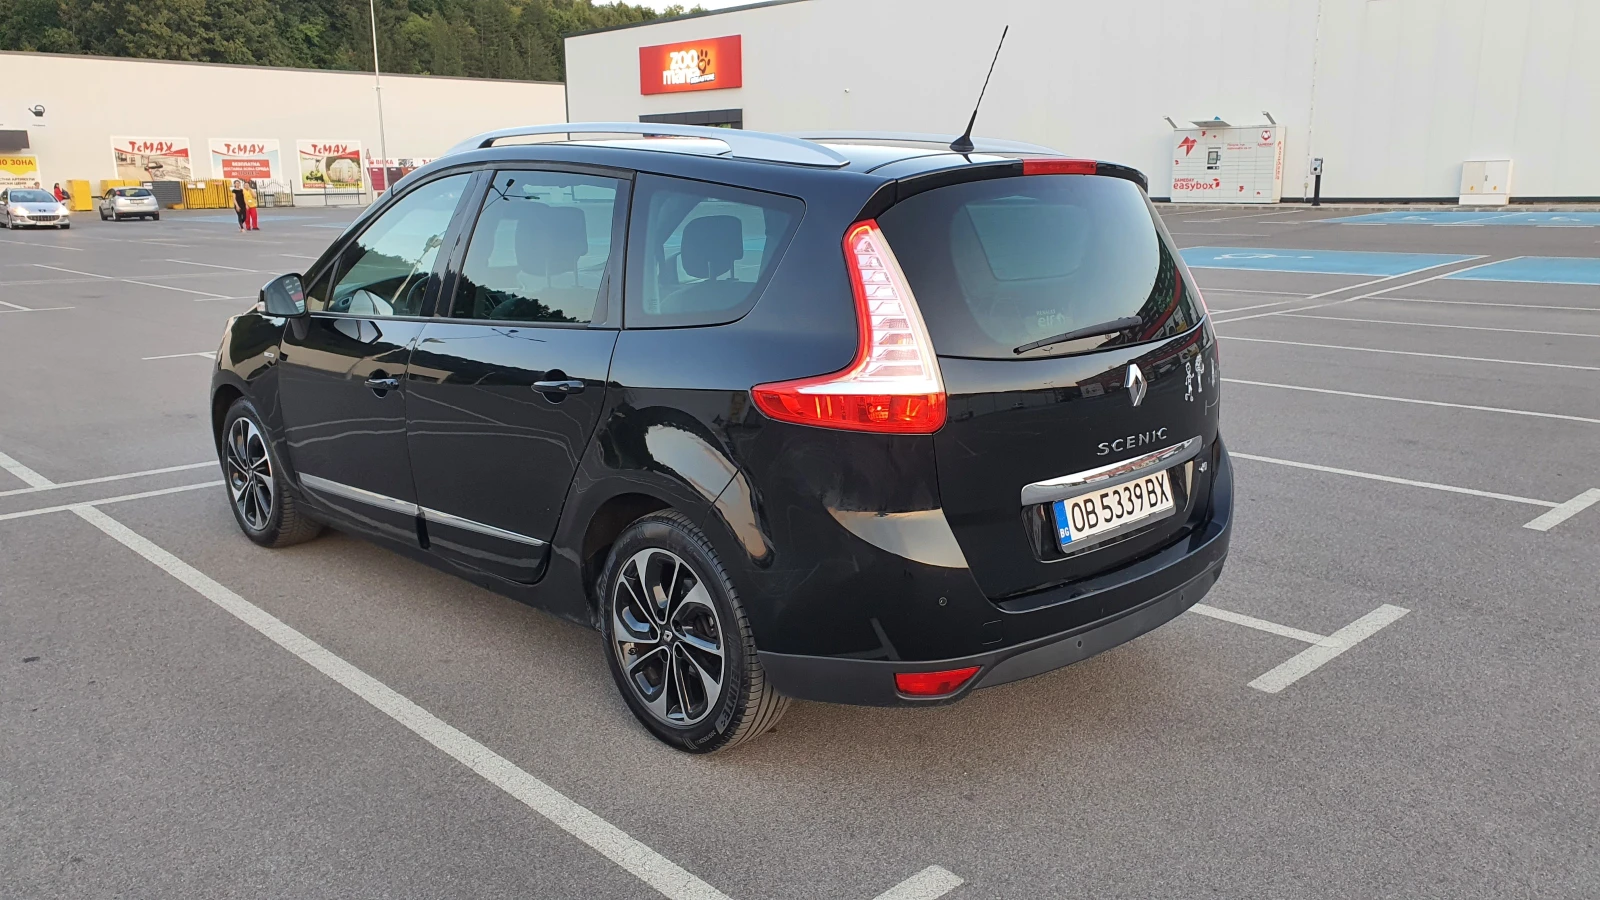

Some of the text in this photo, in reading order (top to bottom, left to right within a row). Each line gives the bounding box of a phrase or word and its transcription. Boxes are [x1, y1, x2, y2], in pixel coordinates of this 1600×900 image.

[1173, 180, 1214, 192] easybox
[1096, 427, 1168, 456] SCENIC
[1060, 527, 1070, 537] BG
